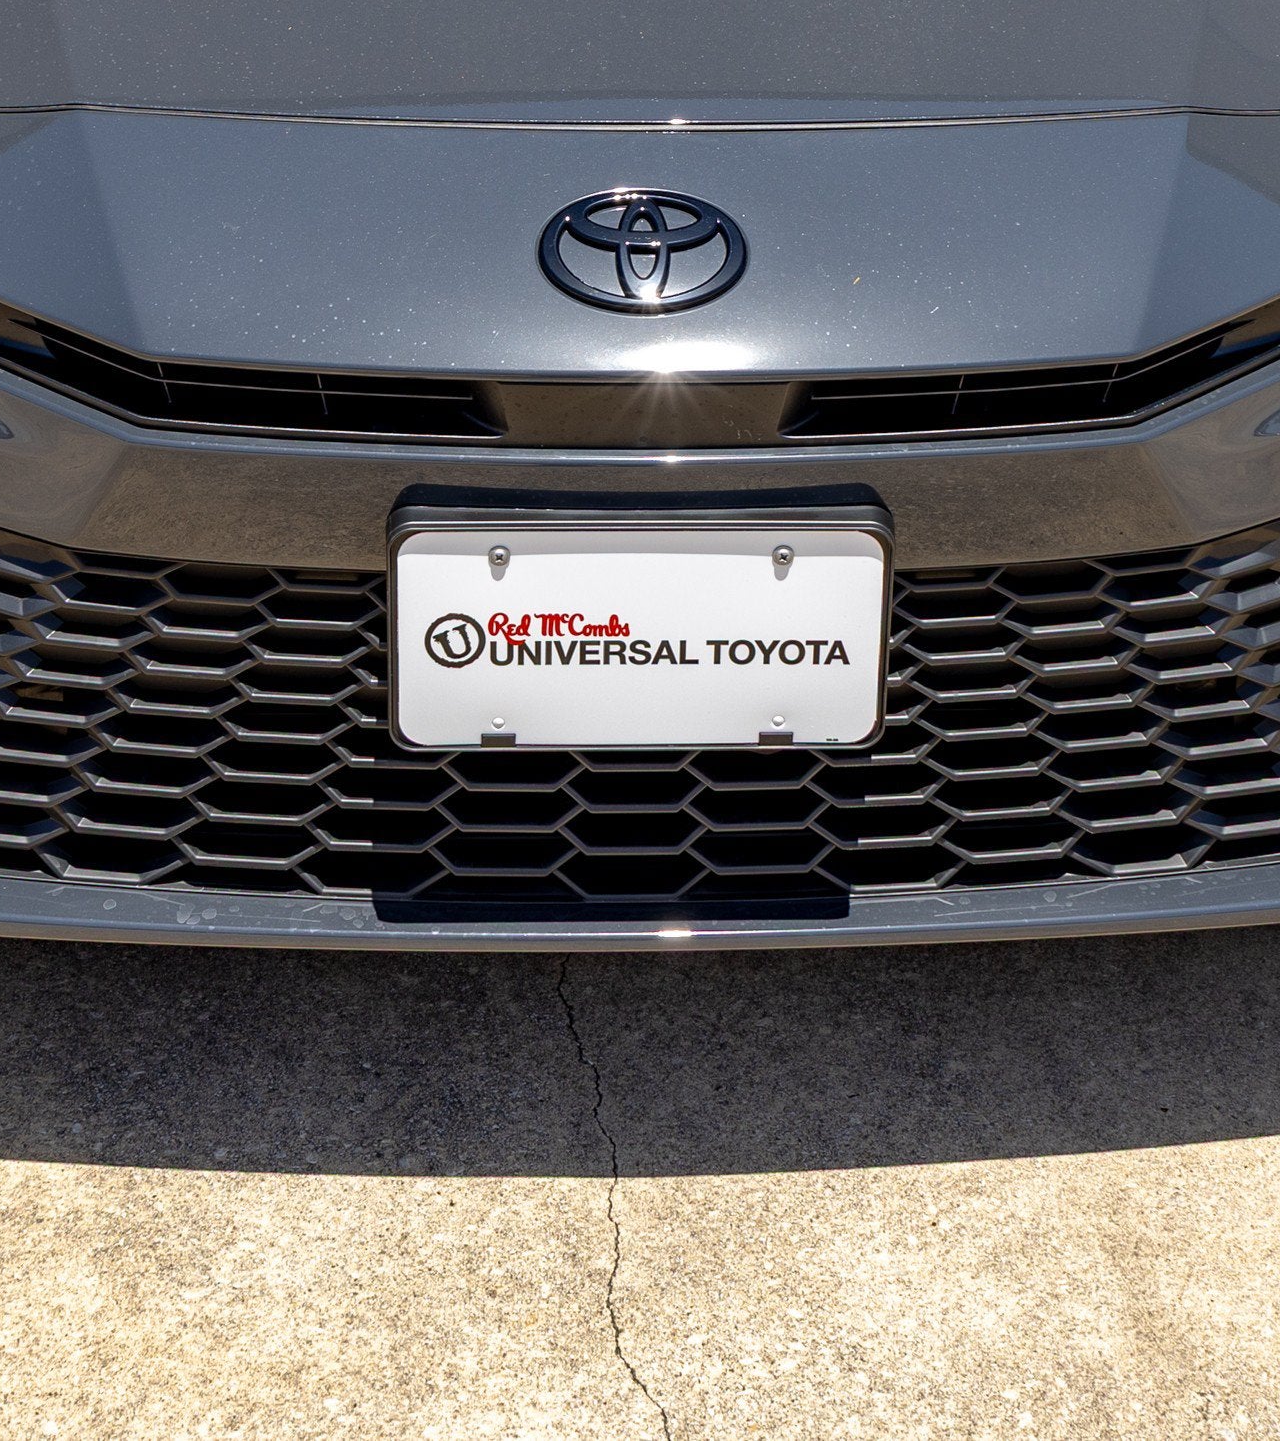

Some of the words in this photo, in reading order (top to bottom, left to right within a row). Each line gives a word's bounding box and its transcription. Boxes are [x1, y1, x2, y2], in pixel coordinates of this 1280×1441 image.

[487, 612, 531, 645] Red
[533, 613, 630, 637] McCombs
[490, 639, 699, 666] UNIVERSAL
[706, 639, 851, 665] TOYOTA
